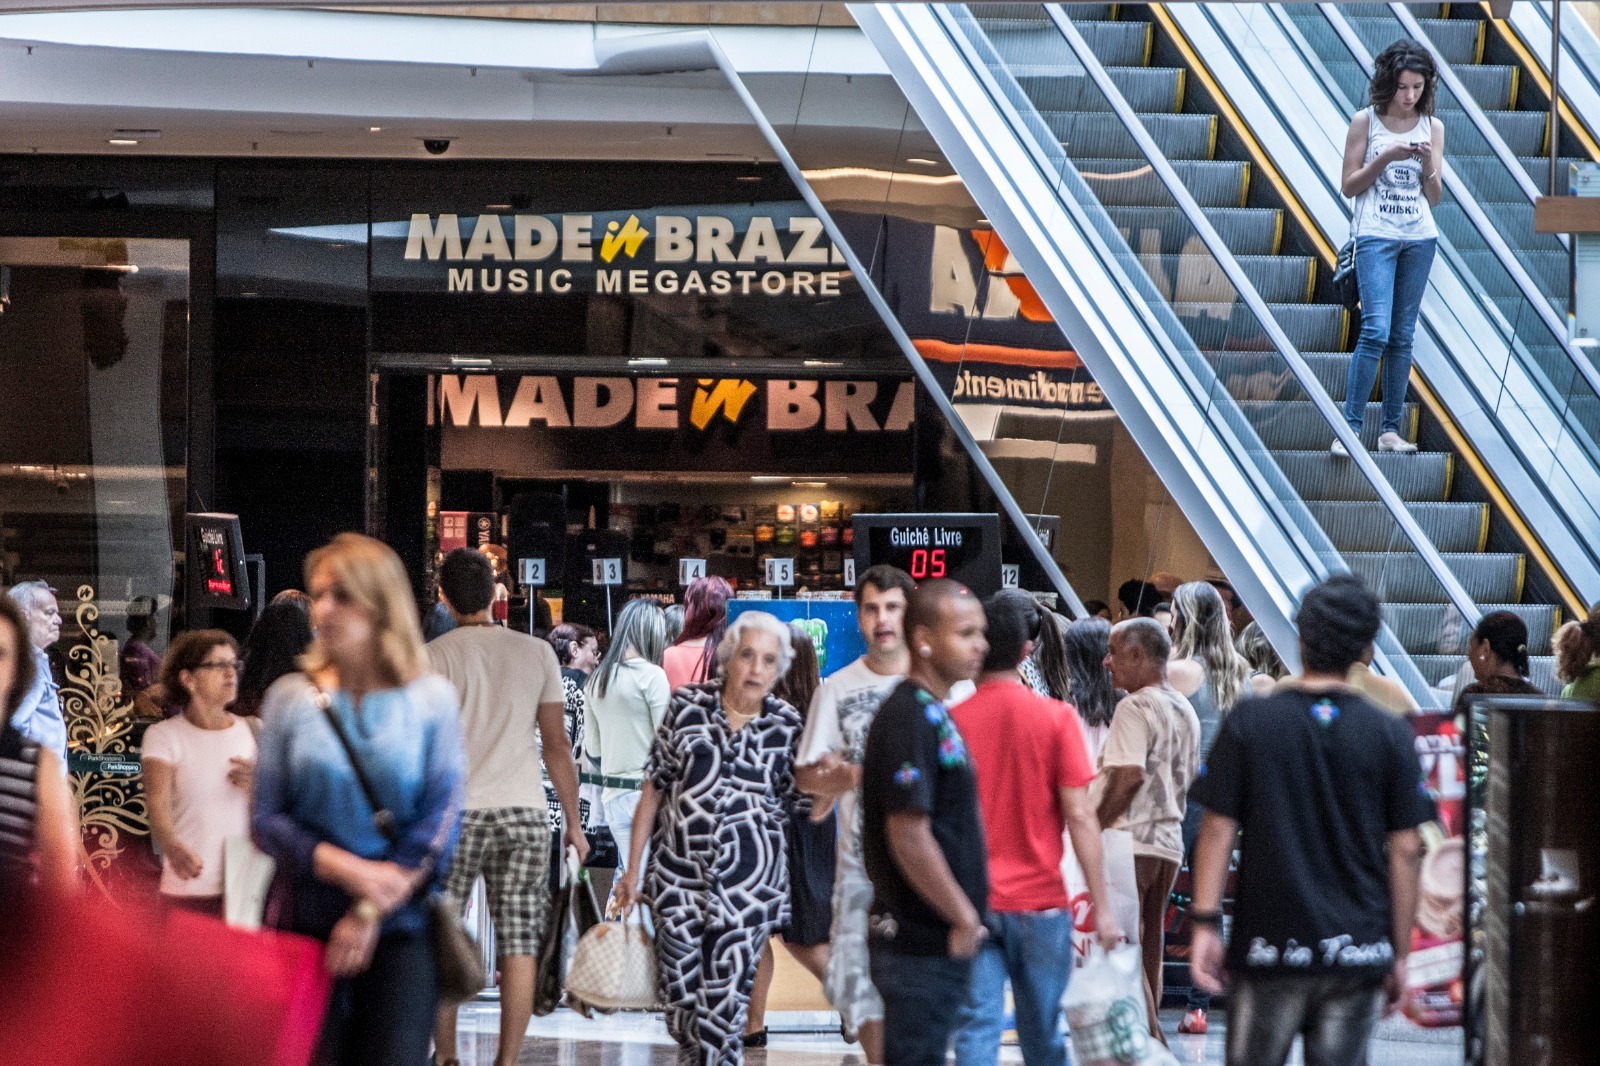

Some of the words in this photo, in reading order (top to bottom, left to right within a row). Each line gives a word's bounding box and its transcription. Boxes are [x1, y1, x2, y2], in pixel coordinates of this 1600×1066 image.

[403, 213, 593, 262] MADE
[447, 268, 573, 293] MUSIC
[595, 269, 841, 296] MEGASTORE
[440, 374, 679, 429] MADE
[891, 527, 929, 545] Guichê
[934, 527, 962, 545] Livre
[531, 563, 540, 580] 2
[609, 563, 617, 580] 3
[780, 564, 789, 581] 5
[911, 549, 946, 578] 05
[1002, 569, 1017, 585] 12
